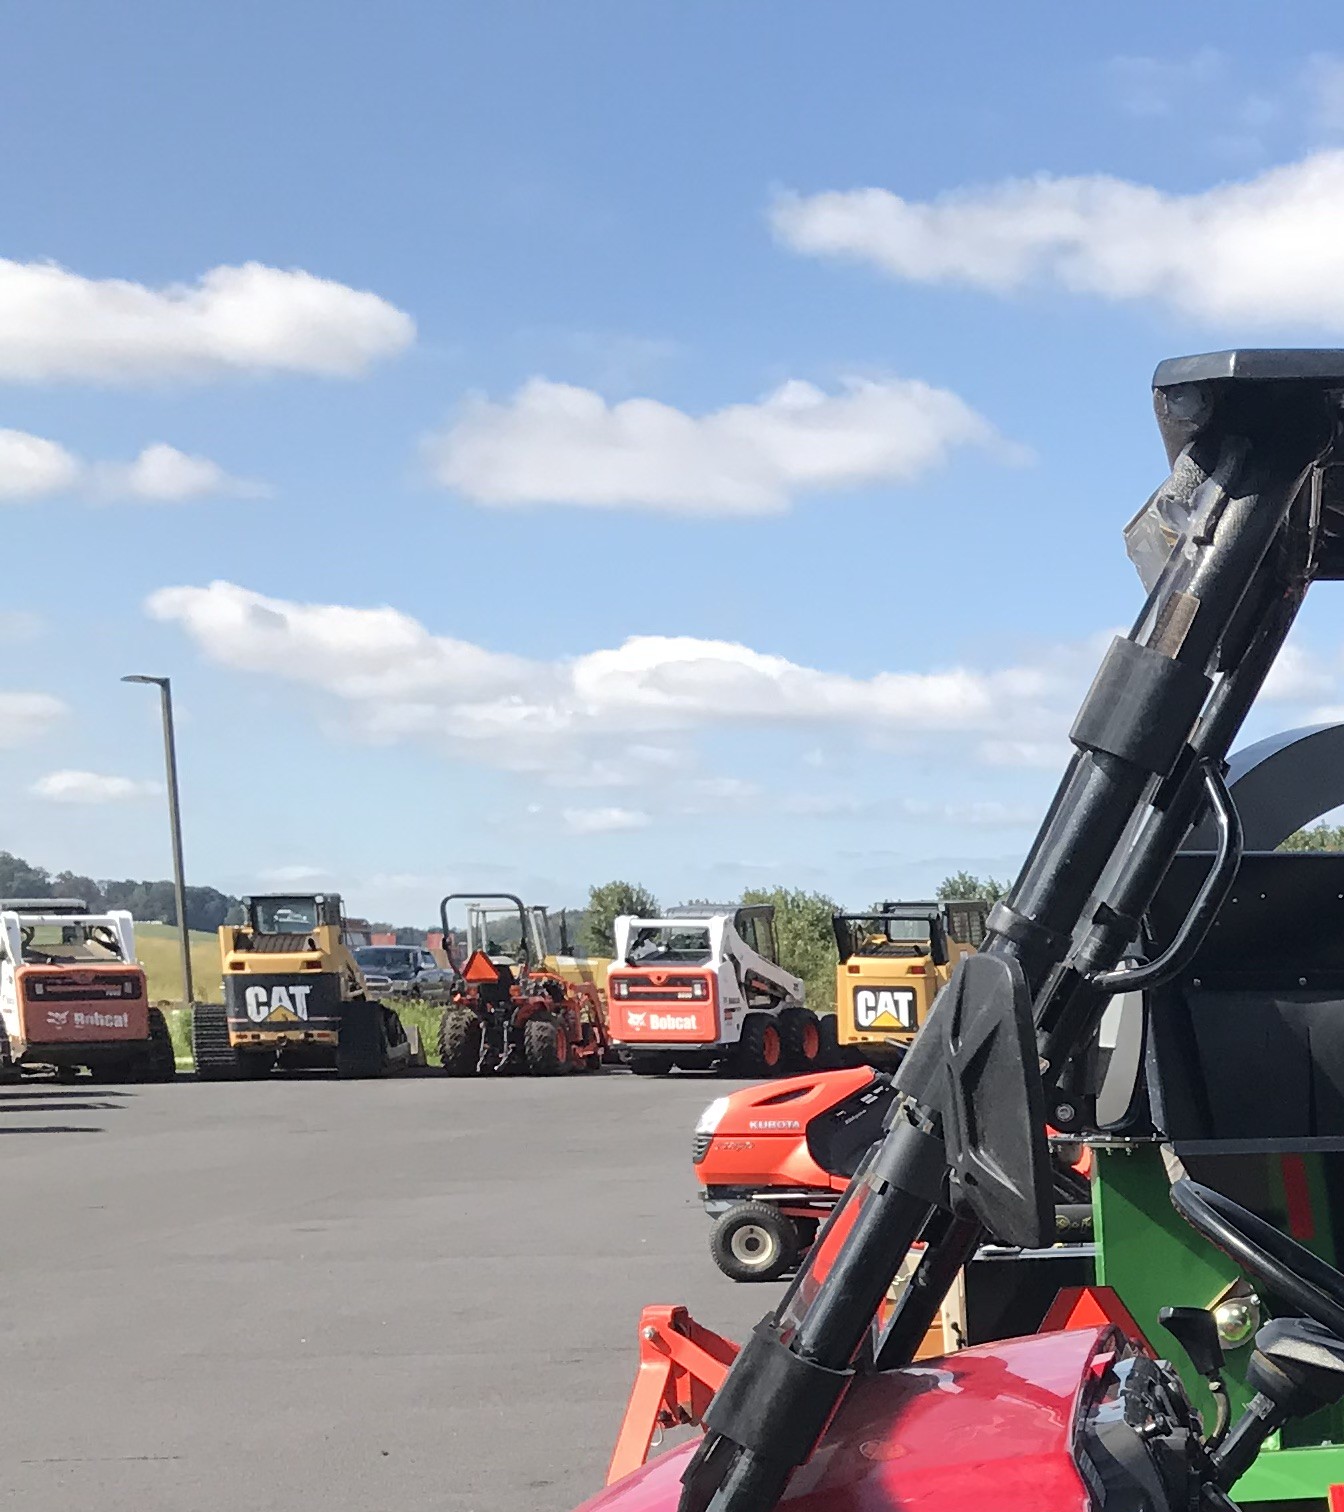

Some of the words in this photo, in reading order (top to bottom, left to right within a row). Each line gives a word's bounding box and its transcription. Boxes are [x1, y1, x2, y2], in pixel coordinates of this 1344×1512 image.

[245, 985, 311, 1022] CAT
[857, 990, 913, 1028] CAT
[74, 1011, 128, 1028] Bobcat
[650, 1013, 697, 1030] Bobcat
[749, 1120, 800, 1130] KUBOTA
